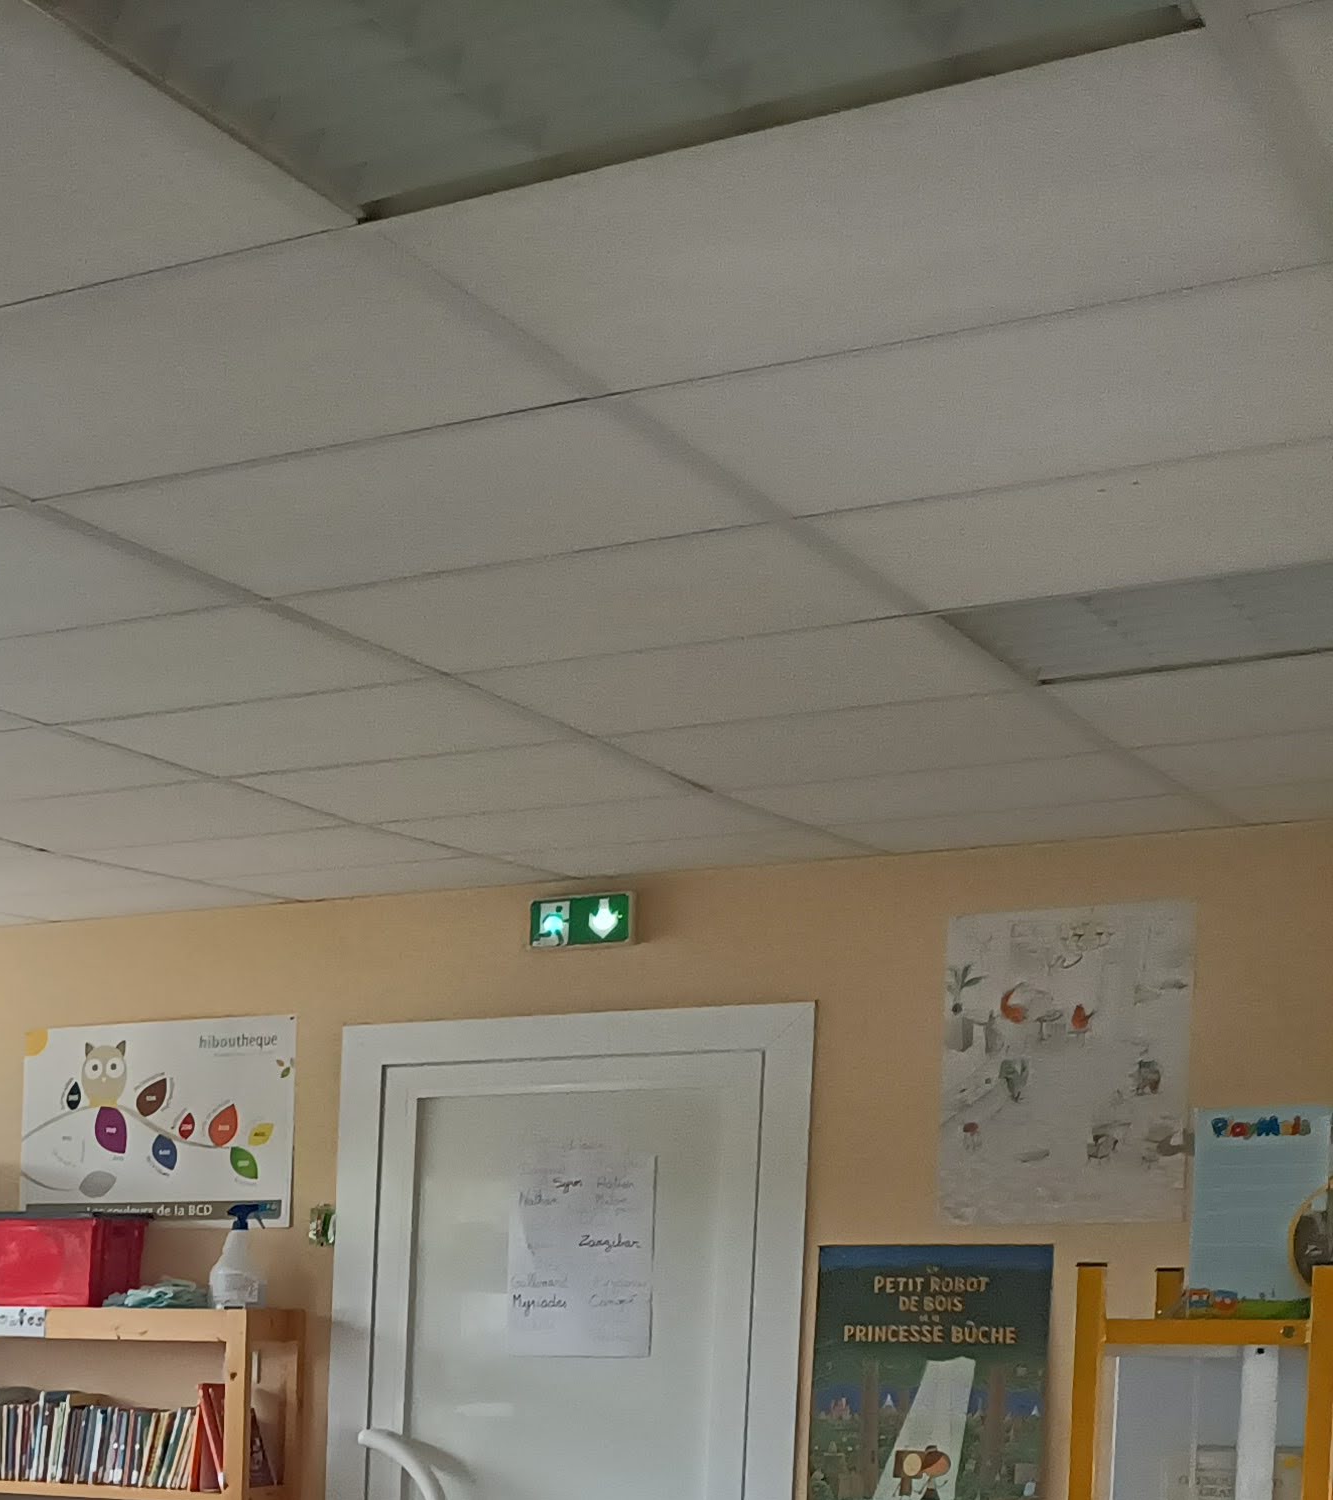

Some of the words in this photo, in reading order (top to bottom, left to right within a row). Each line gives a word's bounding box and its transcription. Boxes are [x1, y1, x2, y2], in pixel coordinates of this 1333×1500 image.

[157, 1206, 171, 1216] de
[174, 1205, 185, 1216] la
[189, 1204, 212, 1216] BCD
[874, 1275, 925, 1294] PETIT
[930, 1275, 990, 1292] ROBOT
[899, 1296, 918, 1312] DE
[923, 1296, 964, 1312] BOIS
[843, 1325, 944, 1343] PRINCESSE
